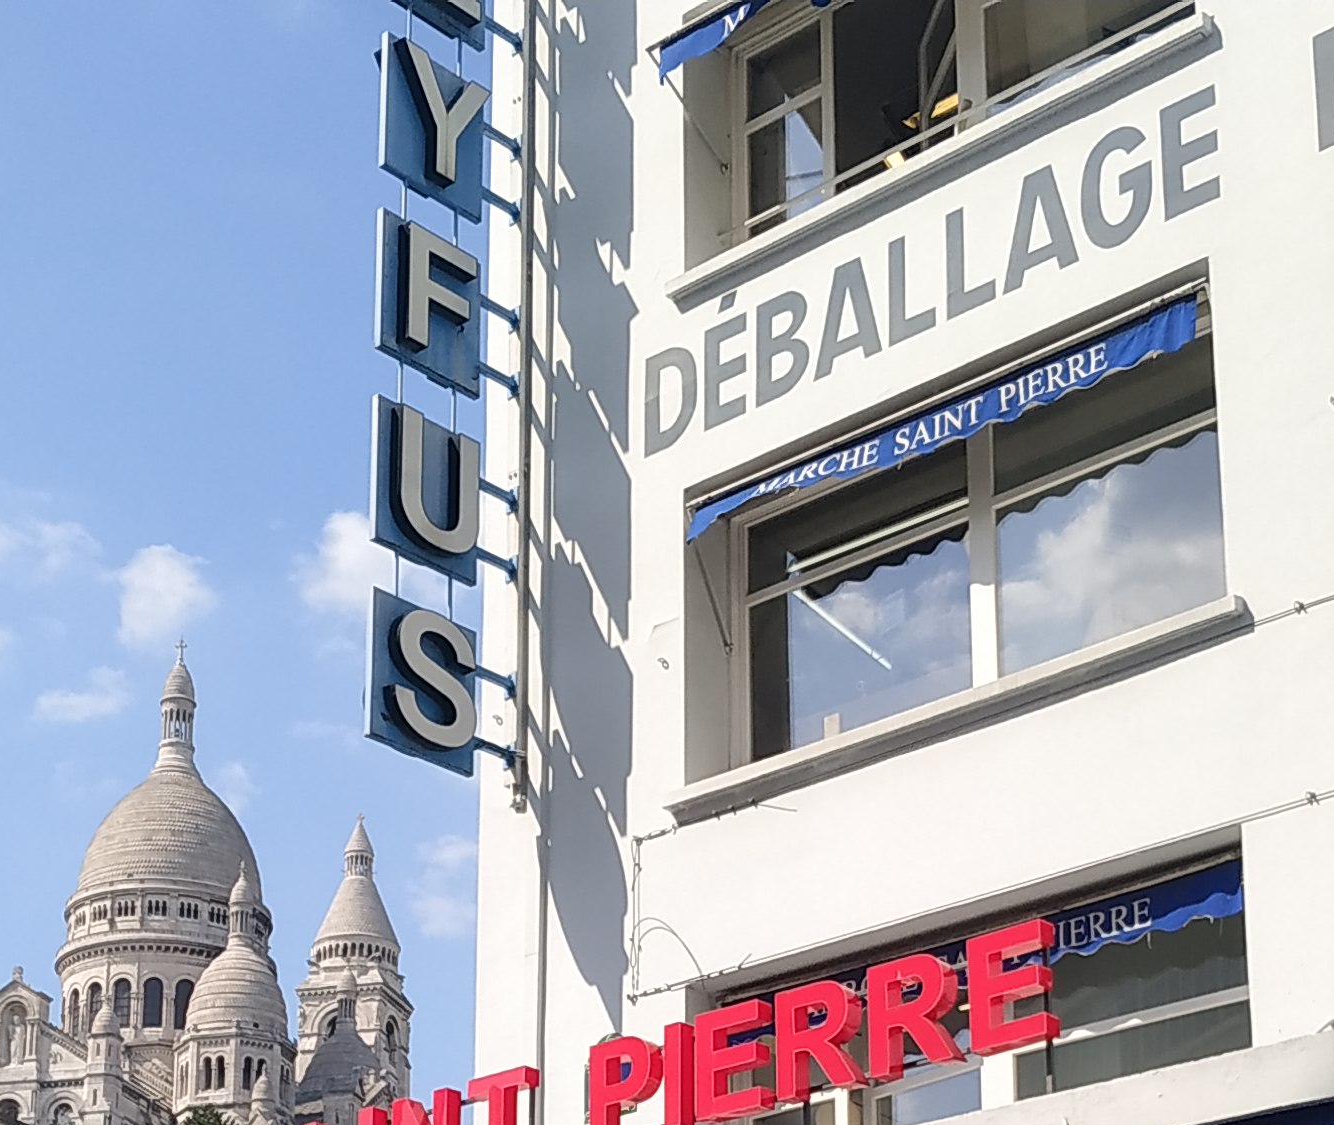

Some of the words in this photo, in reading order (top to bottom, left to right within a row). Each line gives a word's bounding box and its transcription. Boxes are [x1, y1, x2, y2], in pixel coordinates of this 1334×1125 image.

[387, 0, 489, 750] YFUS
[644, 84, 1222, 458] DÉBALLAGE
[752, 440, 879, 496] MARCHE
[894, 395, 984, 455] SAINT
[997, 343, 1108, 413] PIERRE
[1053, 896, 1153, 950] IERRE
